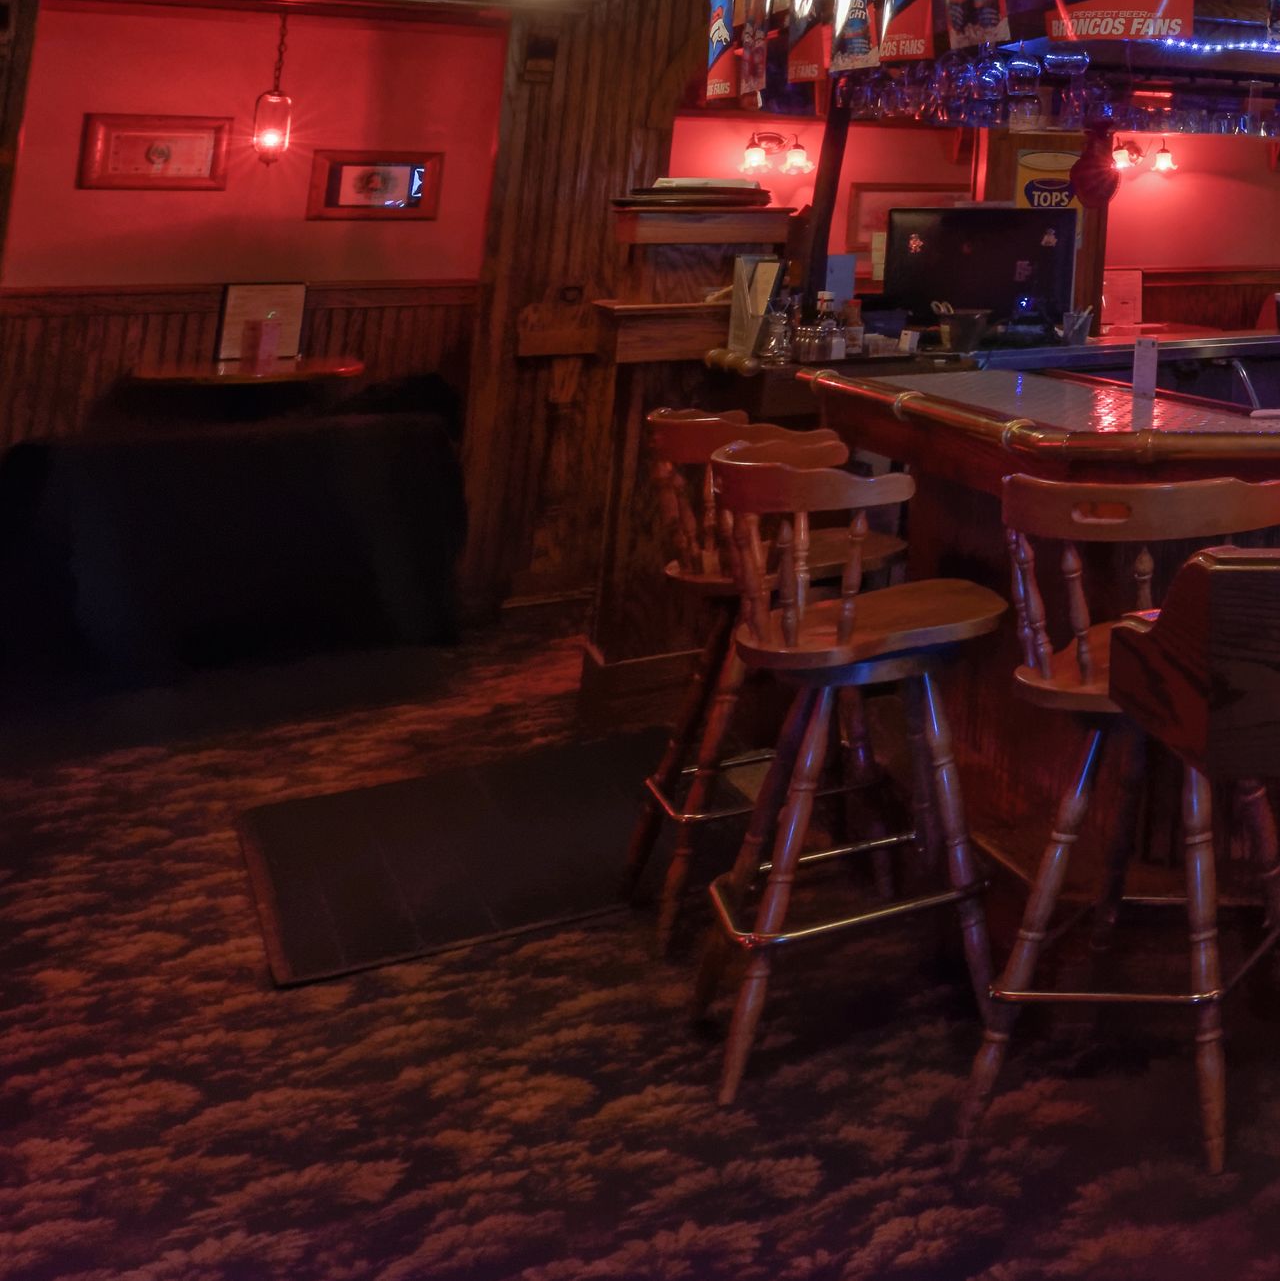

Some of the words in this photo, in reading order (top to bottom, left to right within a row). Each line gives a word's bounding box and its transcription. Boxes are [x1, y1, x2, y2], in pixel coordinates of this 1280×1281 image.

[851, 0, 865, 9] UD
[850, 9, 867, 20] GHT
[1119, 10, 1148, 18] BEER
[1052, 18, 1125, 37] BRONCOS
[1130, 18, 1182, 36] FANS
[899, 39, 926, 56] FANS
[1032, 191, 1070, 207] TOPS
